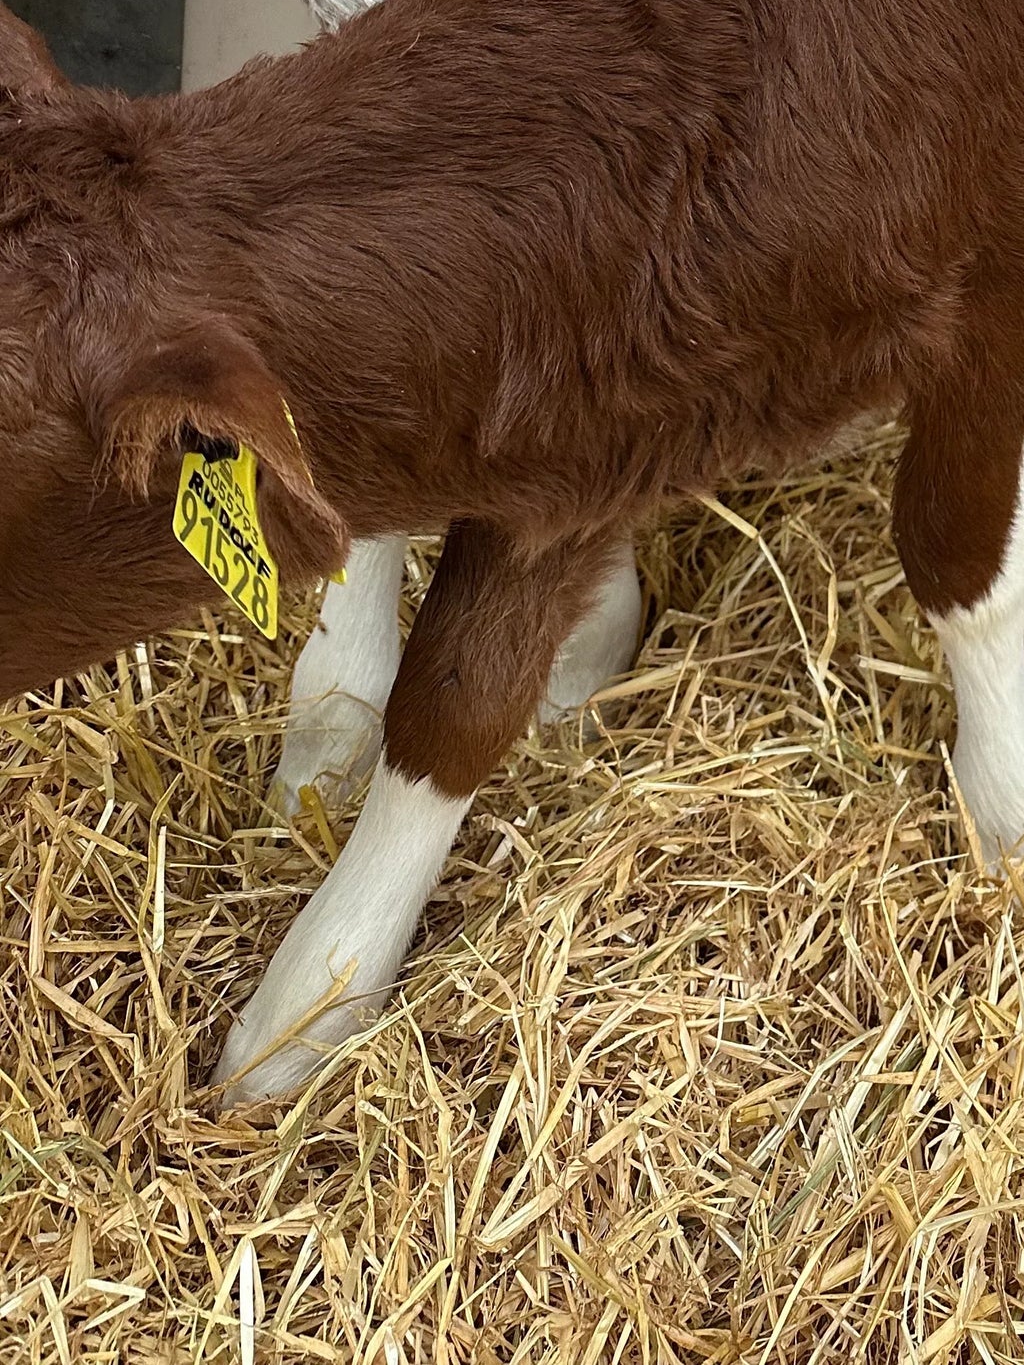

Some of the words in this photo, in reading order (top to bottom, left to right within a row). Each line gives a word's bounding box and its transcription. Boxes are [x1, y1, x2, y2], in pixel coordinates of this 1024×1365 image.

[189, 471, 271, 579] RUDOLF
[203, 461, 260, 545] 0055793
[179, 491, 268, 629] 91528
